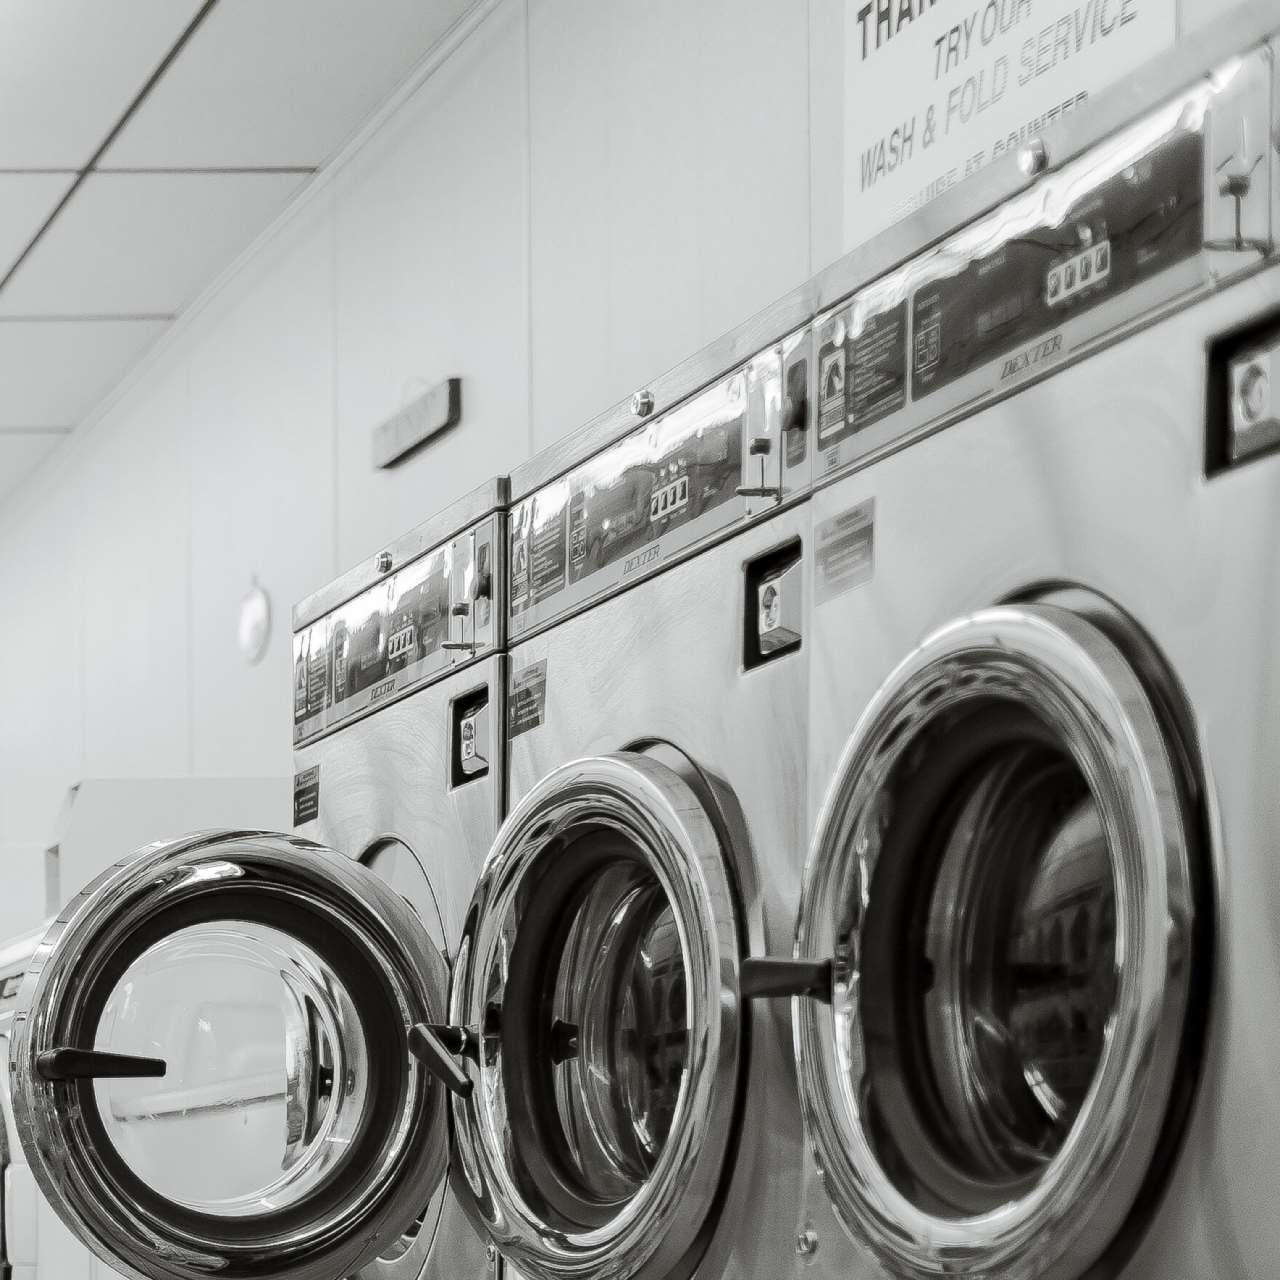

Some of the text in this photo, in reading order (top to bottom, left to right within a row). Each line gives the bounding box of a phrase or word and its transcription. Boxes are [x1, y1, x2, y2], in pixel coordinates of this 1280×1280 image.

[857, 0, 936, 60] THA
[934, 9, 979, 80] TRY
[860, 116, 916, 192] WASH
[922, 103, 936, 149] &
[944, 55, 1008, 135] FOLD
[1018, 0, 1139, 87] SERVICE
